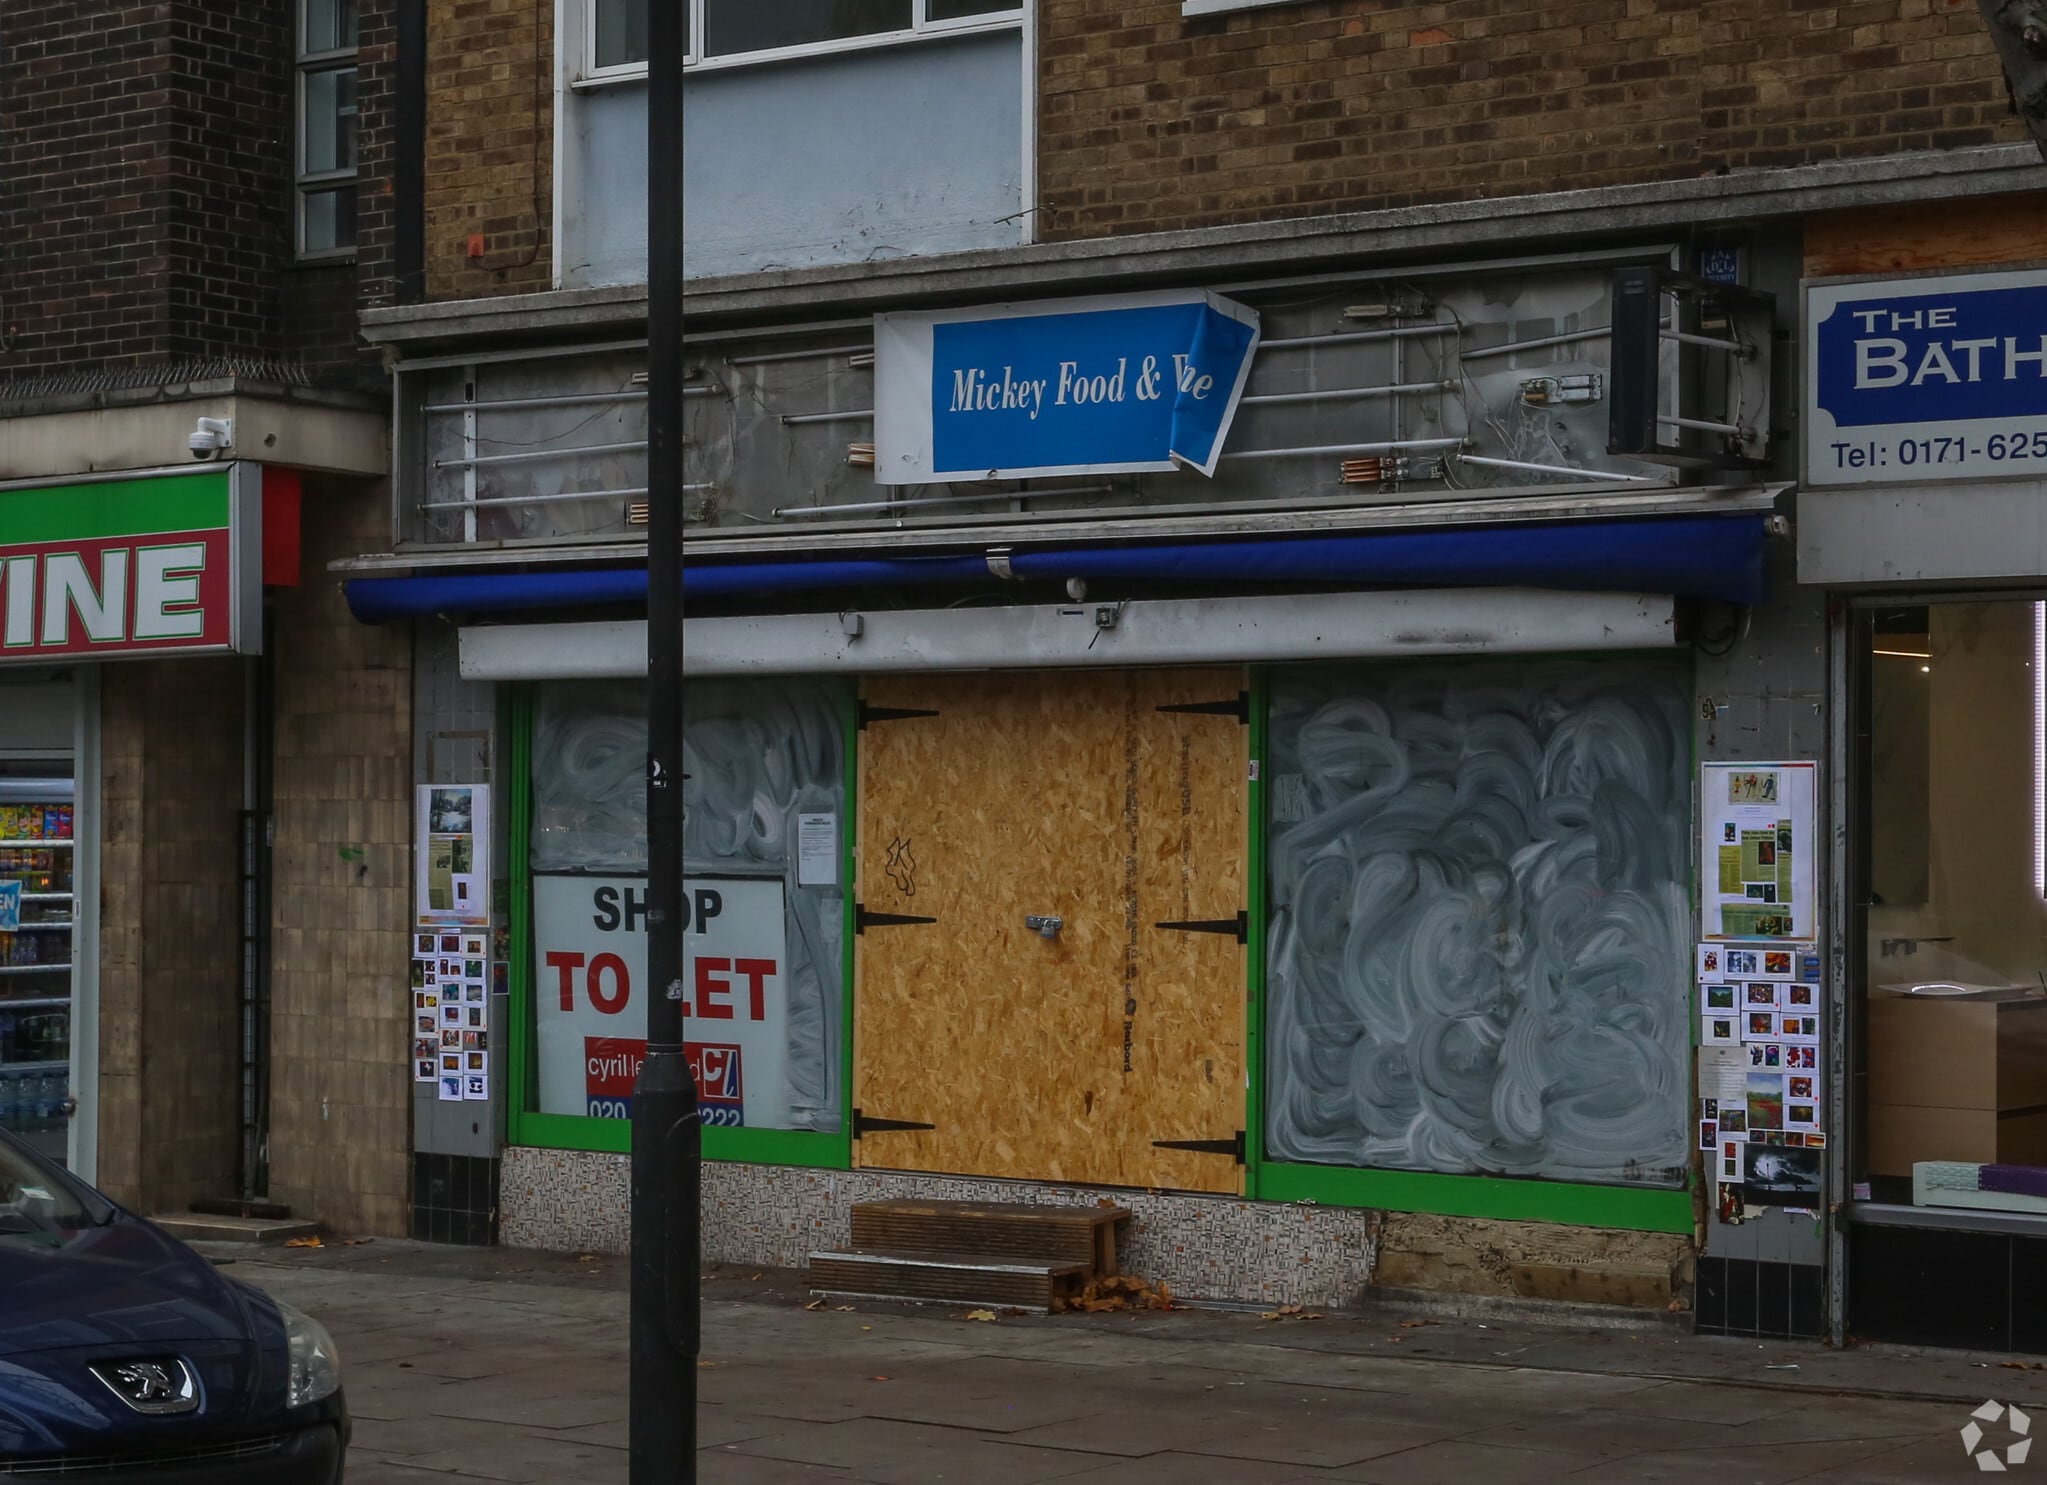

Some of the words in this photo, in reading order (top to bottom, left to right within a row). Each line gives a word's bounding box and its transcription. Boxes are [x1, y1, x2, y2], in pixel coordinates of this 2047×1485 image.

[1853, 307, 1957, 333] THE
[1854, 336, 2047, 389] BATH
[949, 365, 1046, 420] Mickey
[1054, 358, 1128, 406] Food
[1136, 355, 1160, 400] &
[1831, 443, 1887, 468] Tel:
[1899, 432, 2047, 466] 0171-625
[0, 541, 206, 648] INE
[592, 886, 723, 934] SHP
[546, 951, 631, 1015] TO
[683, 956, 777, 1021] ET
[588, 1053, 627, 1082] cyril
[589, 1100, 626, 1119] 020
[697, 1107, 741, 1126] 222
